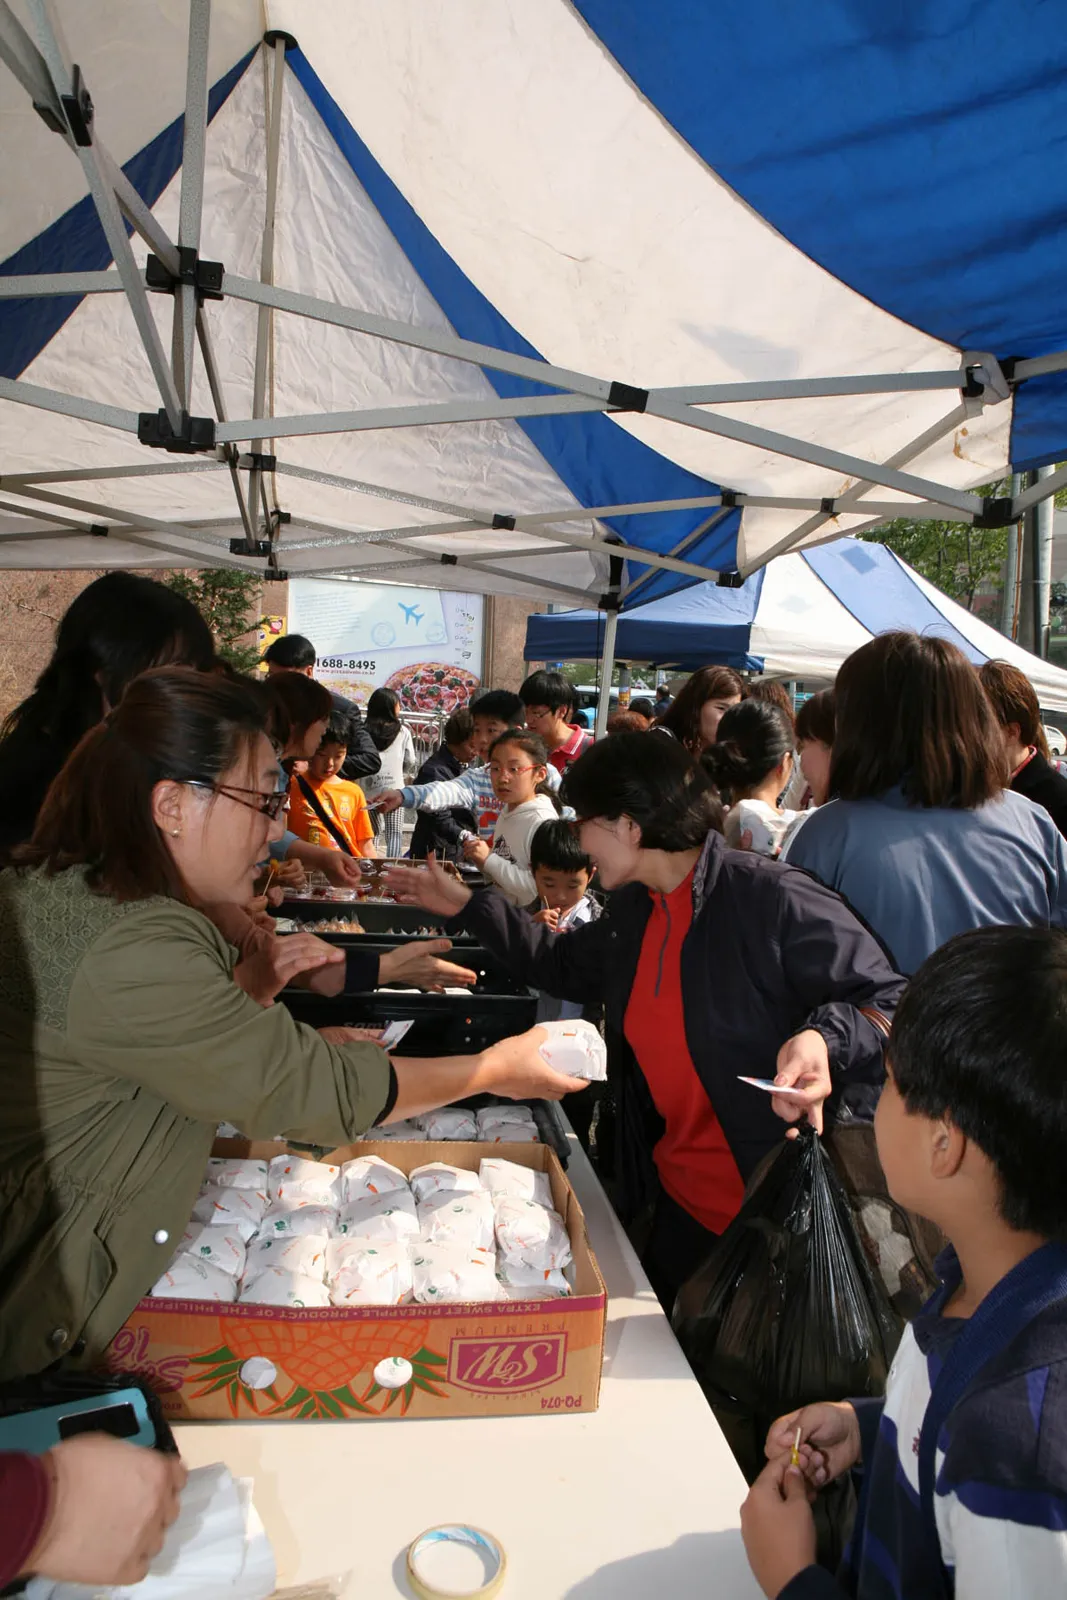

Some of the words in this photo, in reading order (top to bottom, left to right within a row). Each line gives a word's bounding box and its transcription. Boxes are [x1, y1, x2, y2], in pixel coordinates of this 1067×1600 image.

[316, 657, 376, 671] 1688-8495
[139, 1300, 214, 1313] PHILIPPIN
[220, 1305, 249, 1315] THE
[444, 1306, 493, 1316] SWEET
[497, 1302, 541, 1313] EXTRA
[255, 1309, 274, 1318] OF
[279, 1309, 349, 1320] PRODUCT
[363, 1307, 441, 1318] PINEAPPLE
[455, 1321, 565, 1336] PREMIUM
[461, 1341, 553, 1386] S&W
[540, 1395, 582, 1409] PQ-074
